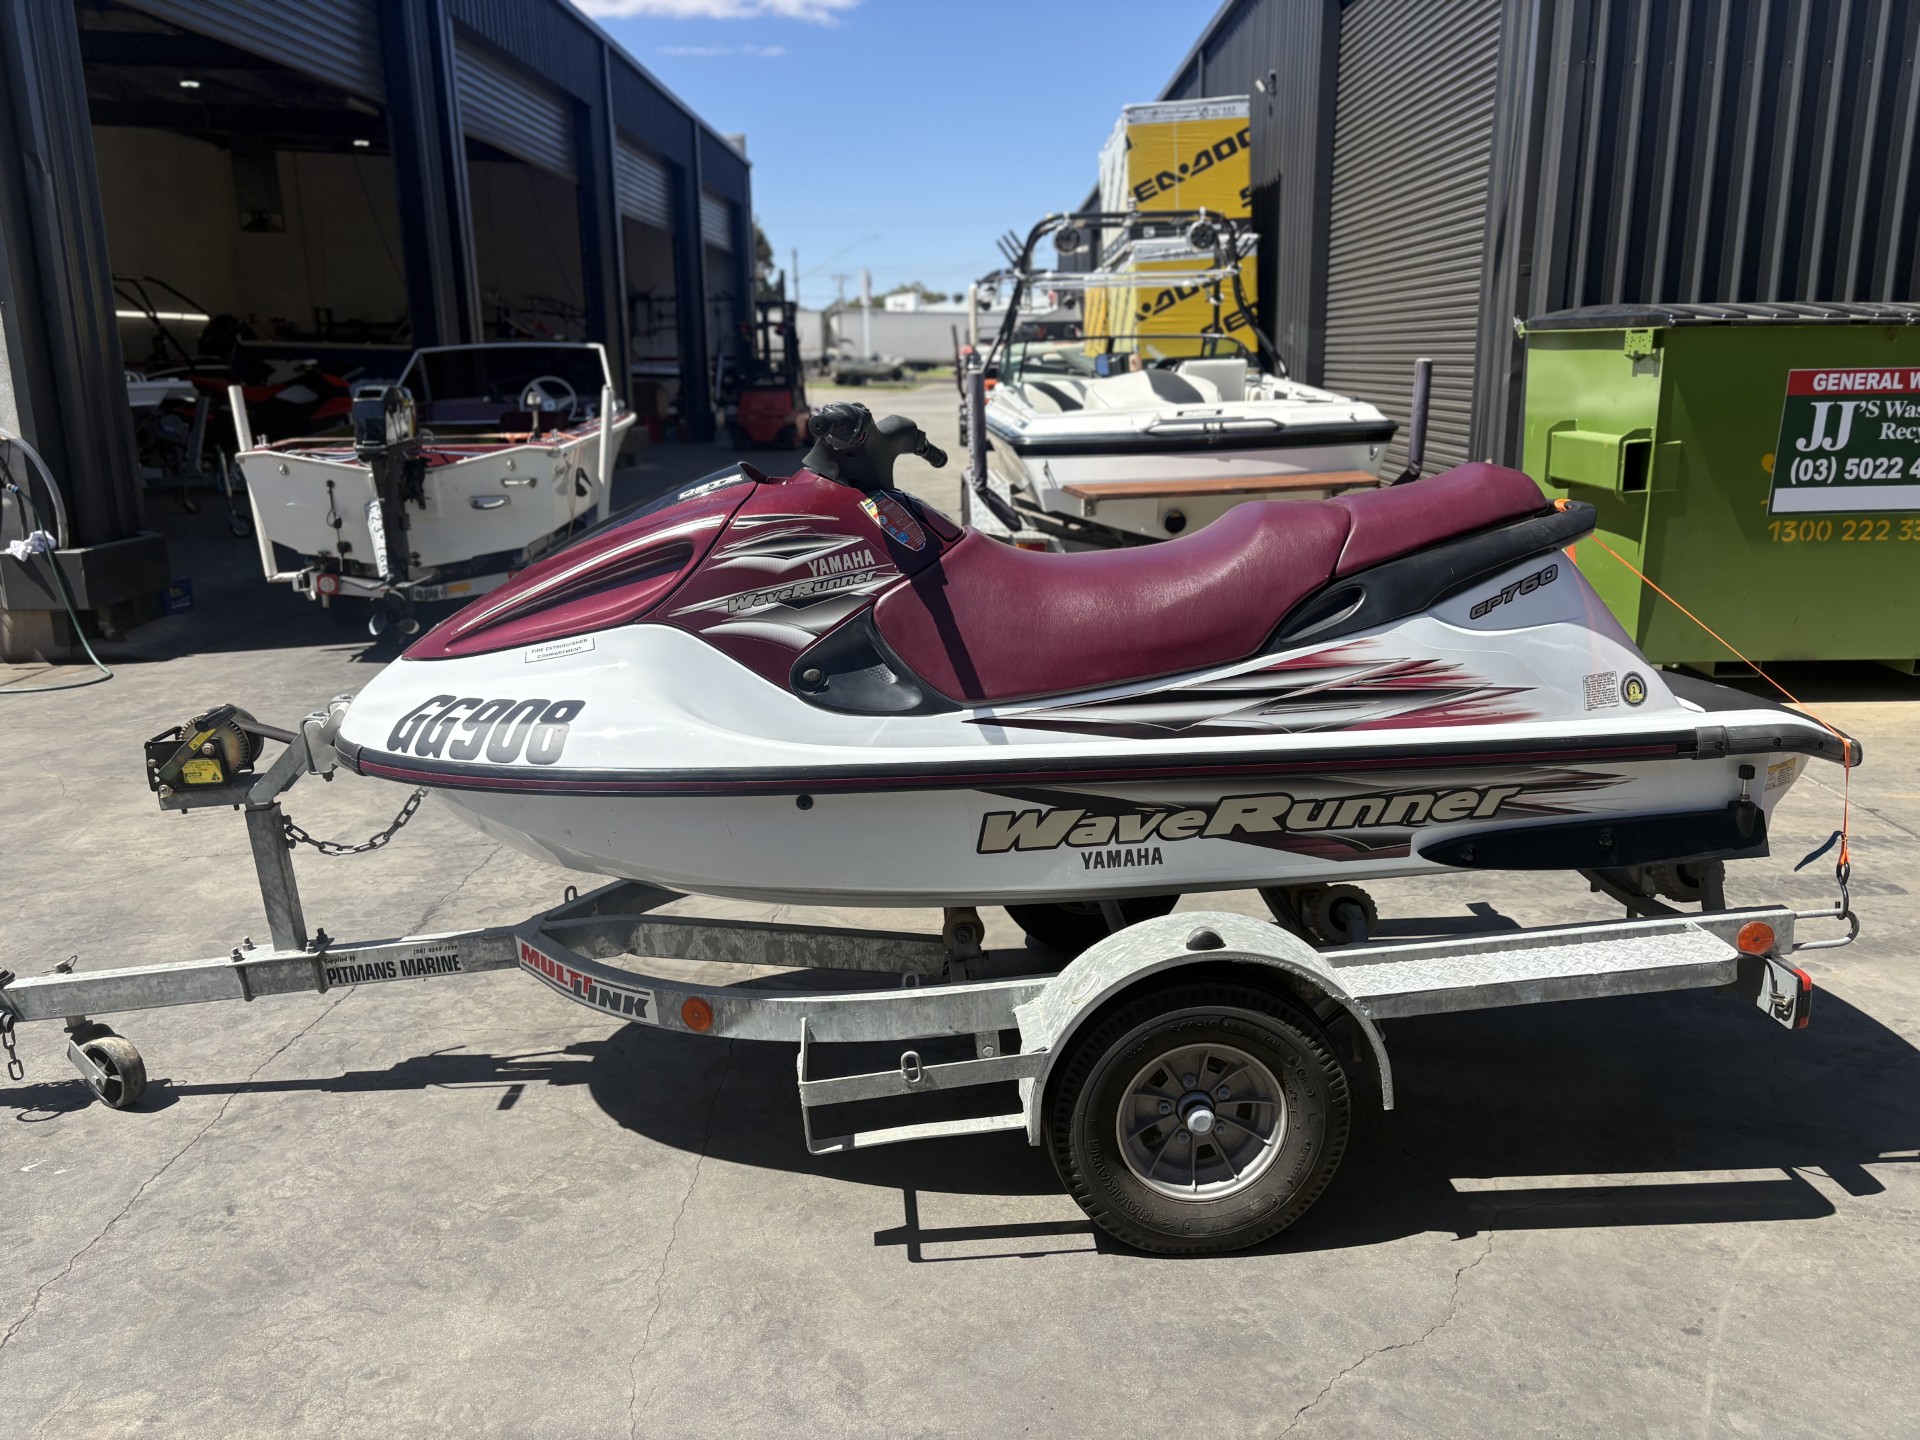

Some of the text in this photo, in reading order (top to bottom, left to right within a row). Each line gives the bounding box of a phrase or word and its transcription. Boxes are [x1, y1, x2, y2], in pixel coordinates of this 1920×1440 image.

[1813, 372, 1904, 391] GENERAL
[1790, 456, 1837, 485] (03)
[1843, 456, 1904, 480] 5022
[1767, 520, 1833, 542] 1300
[1841, 519, 1891, 541] 222
[807, 549, 875, 577] YAMAHA
[728, 571, 877, 613] WaveRunner
[1469, 563, 1558, 620] GP760
[537, 646, 582, 659] COMPARTMENT
[545, 638, 588, 652] EXTINGUISHER
[386, 694, 586, 765] GG908
[976, 783, 1527, 855] WaveRunner
[1081, 846, 1163, 870] YAMAHA
[326, 954, 462, 985] PITMANS MARINE
